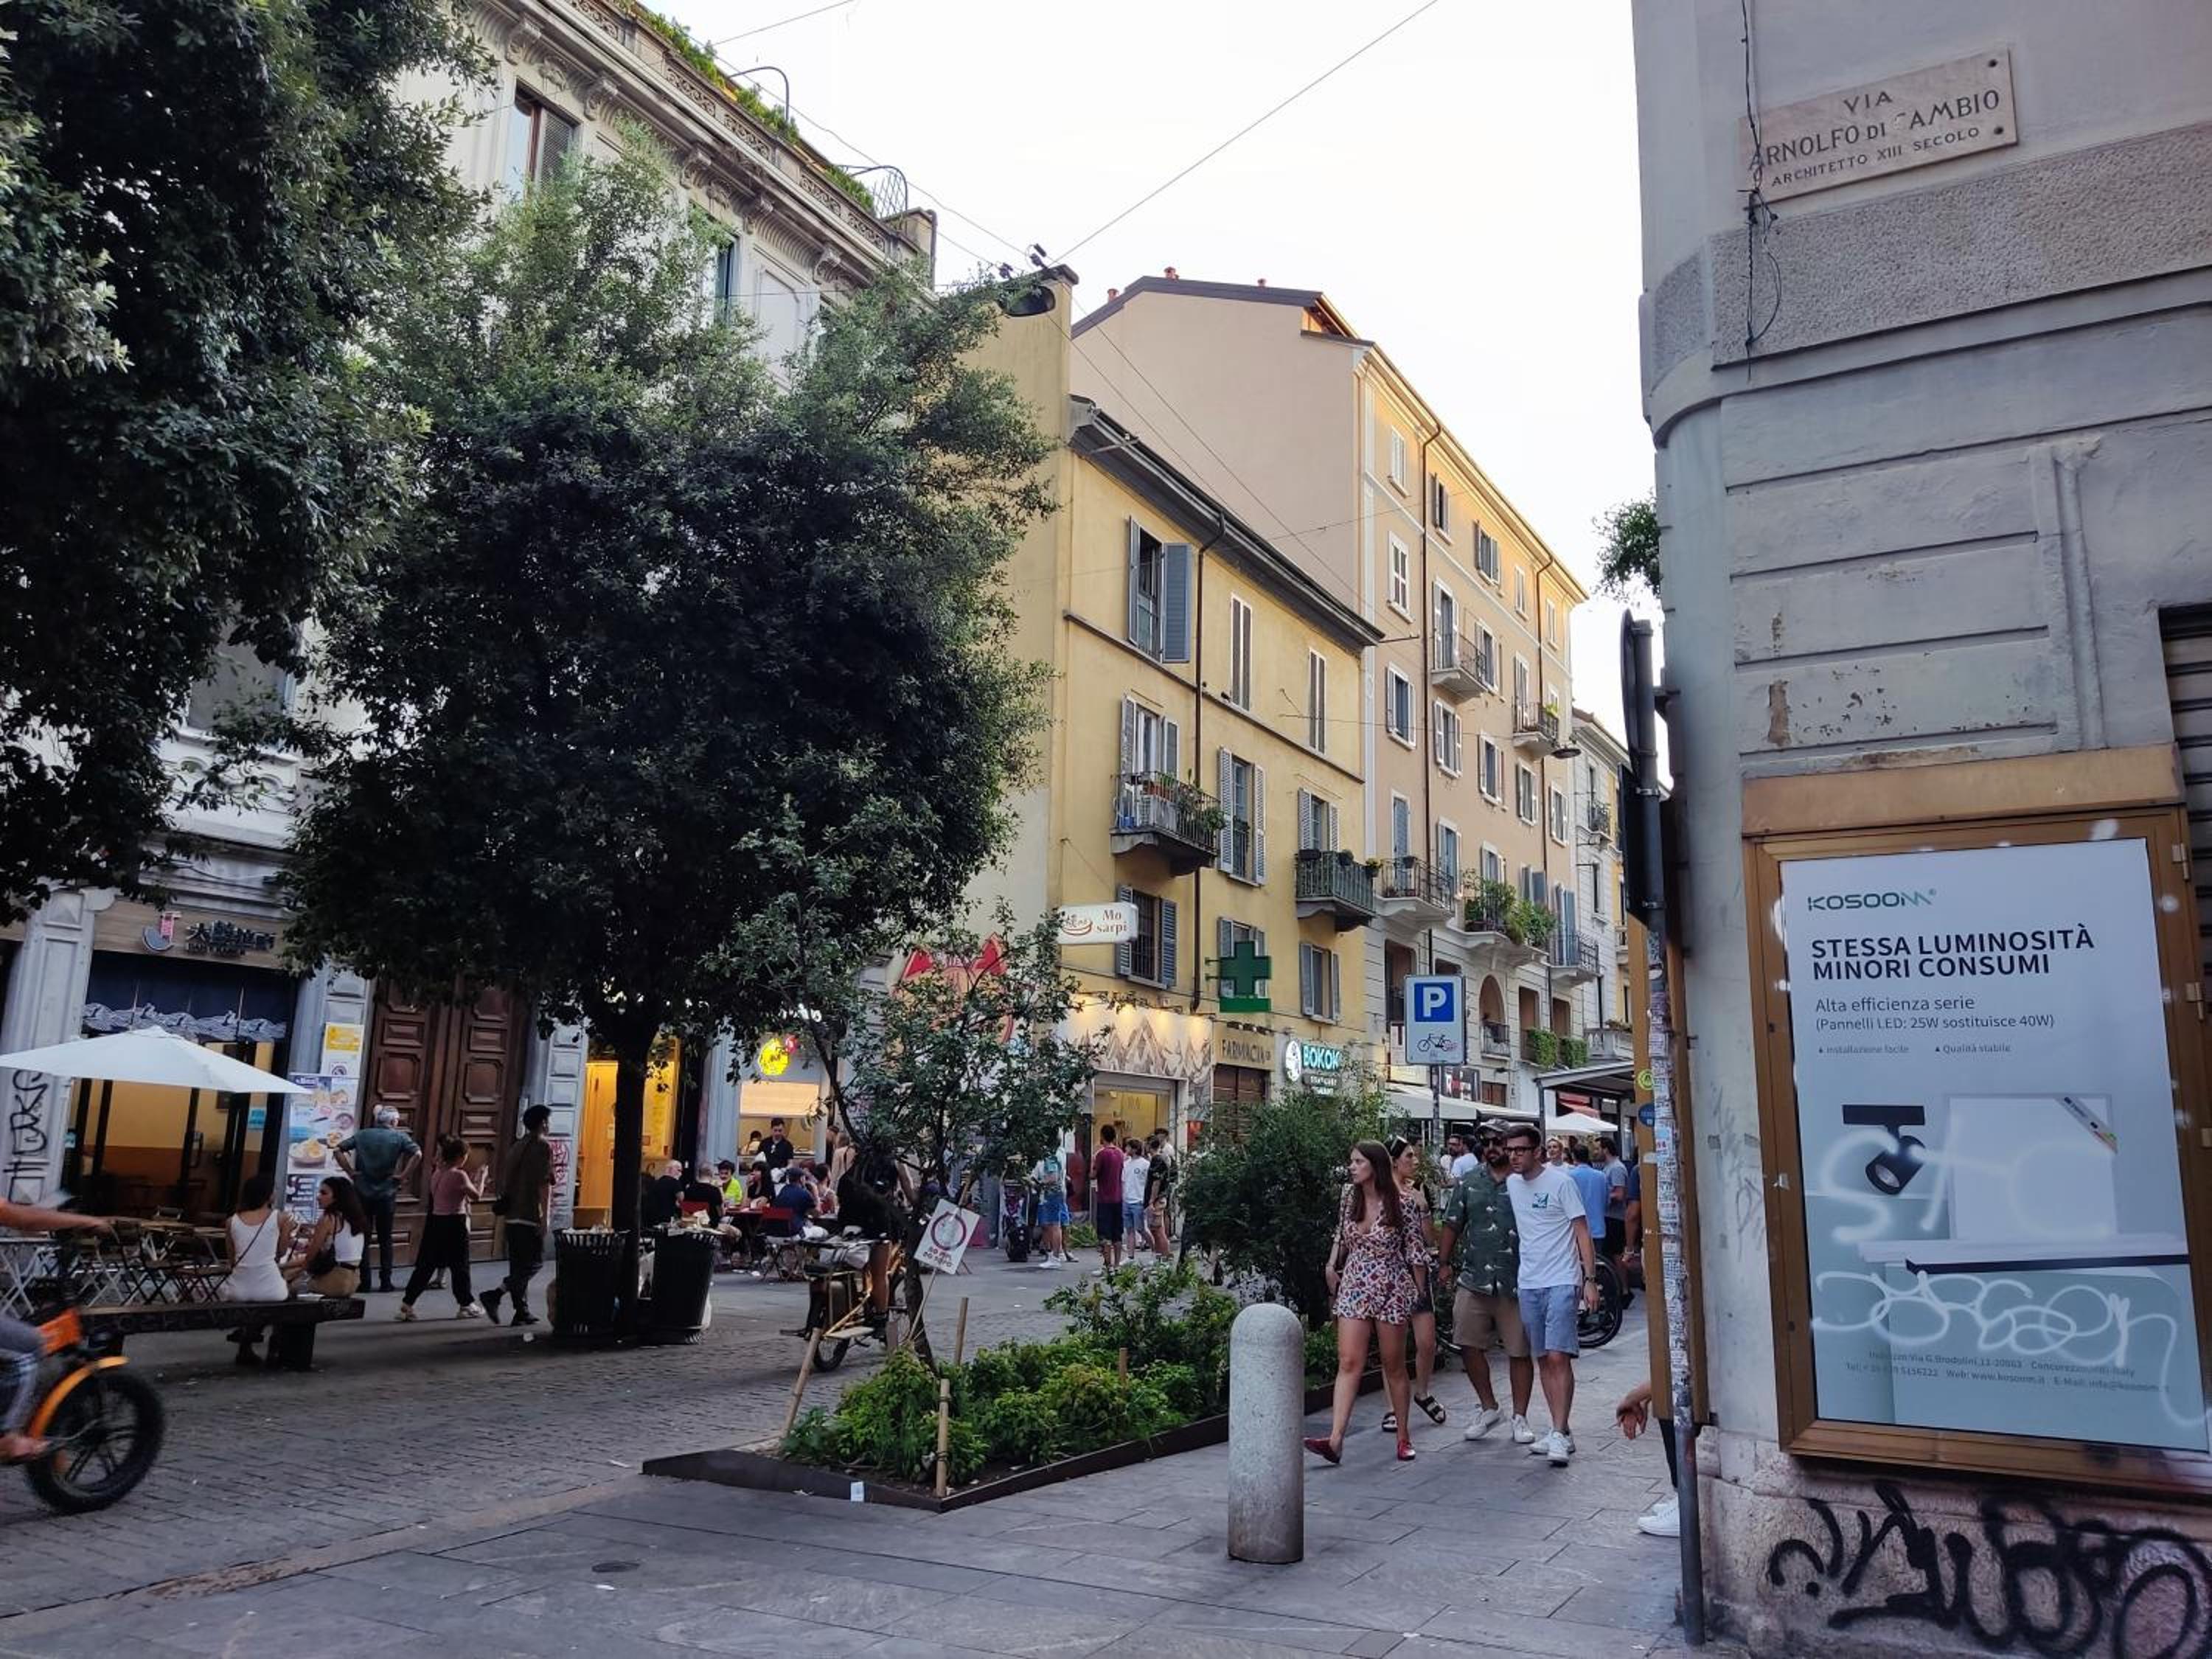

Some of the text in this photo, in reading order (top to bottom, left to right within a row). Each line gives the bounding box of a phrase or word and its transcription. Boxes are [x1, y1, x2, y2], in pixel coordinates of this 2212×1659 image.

[1843, 91, 1893, 114] VIA
[1867, 122, 1886, 141] DI
[1771, 127, 1980, 187] ARCHITETTO XIII SECOLO
[1811, 922, 2095, 959] STESSA LUMINOSITÀ
[1812, 954, 2050, 980] MINORI CONSUMI
[1423, 986, 1447, 1018] P
[1815, 995, 1975, 1012] Alta efficienza serie
[1815, 1014, 2055, 1032] (Pannelli LED: 25W sostituisce 40W)
